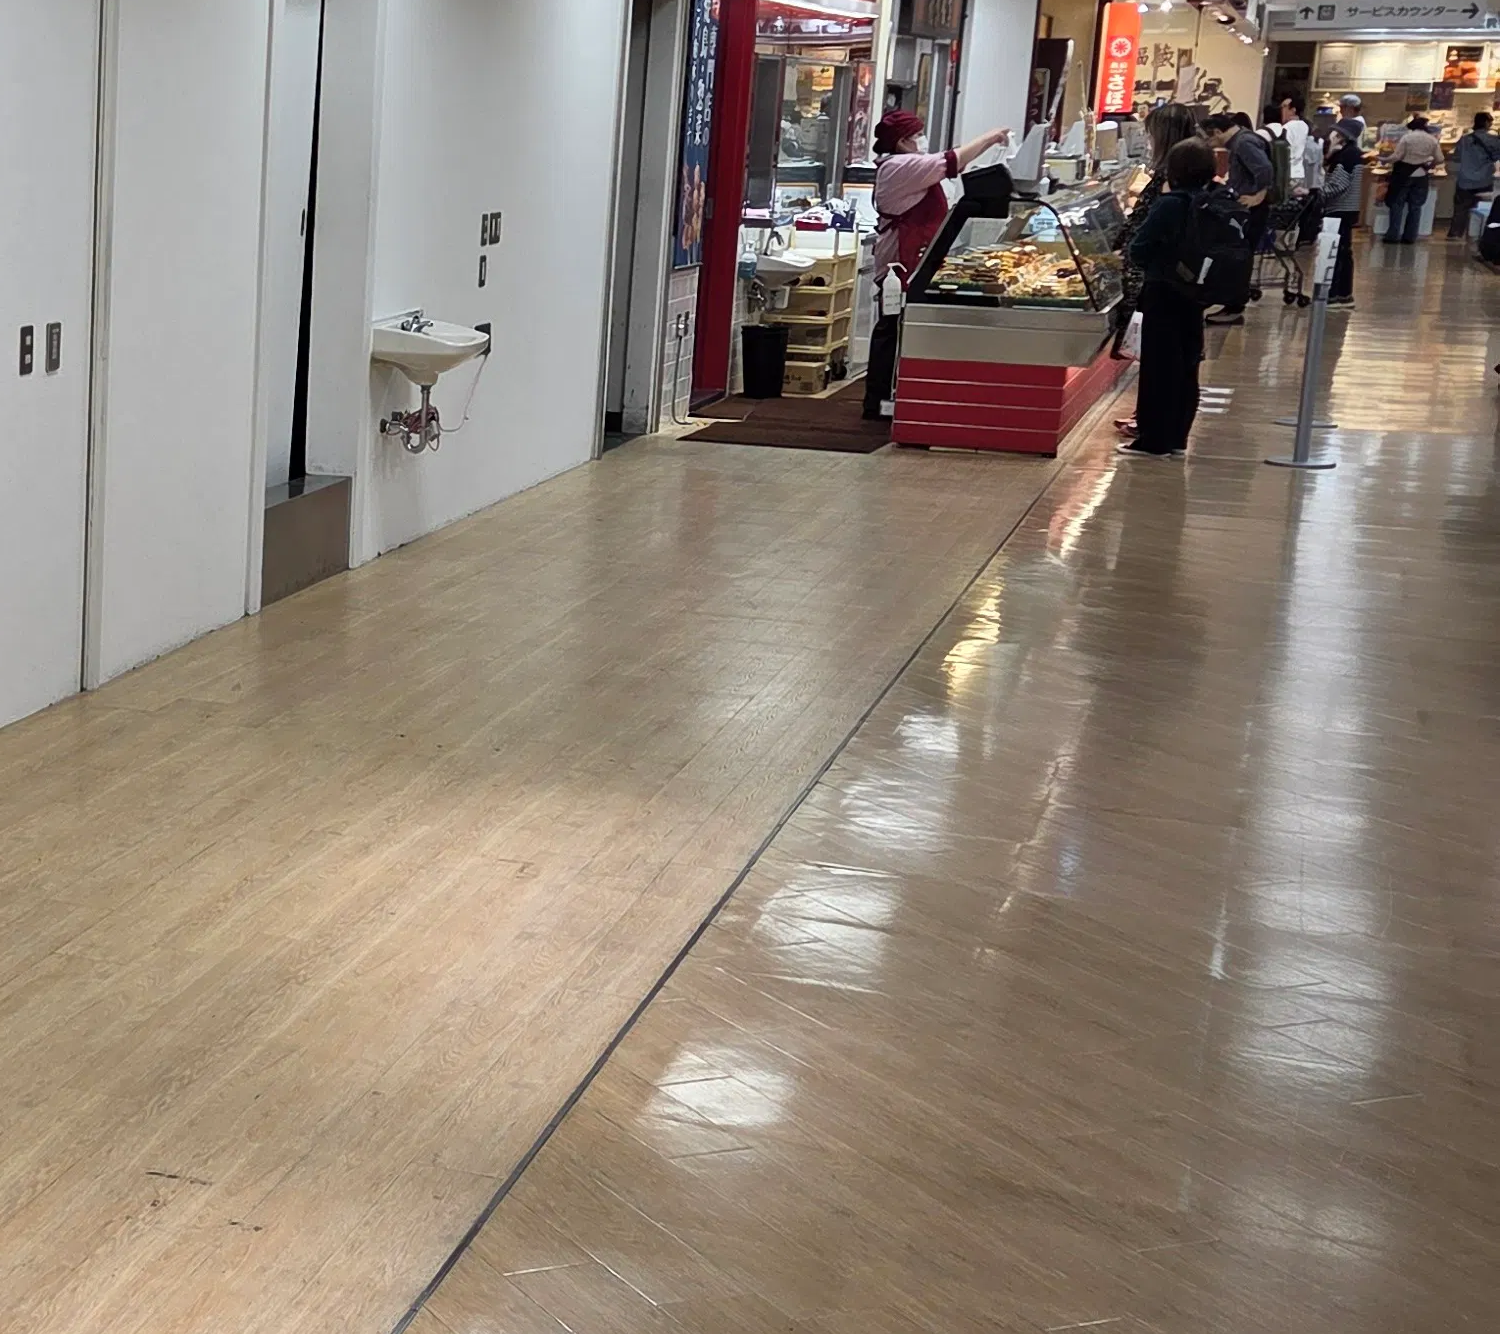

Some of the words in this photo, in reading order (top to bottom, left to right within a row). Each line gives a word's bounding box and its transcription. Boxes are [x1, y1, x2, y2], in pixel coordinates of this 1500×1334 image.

[1347, 5, 1458, 17] サービスカウンター
